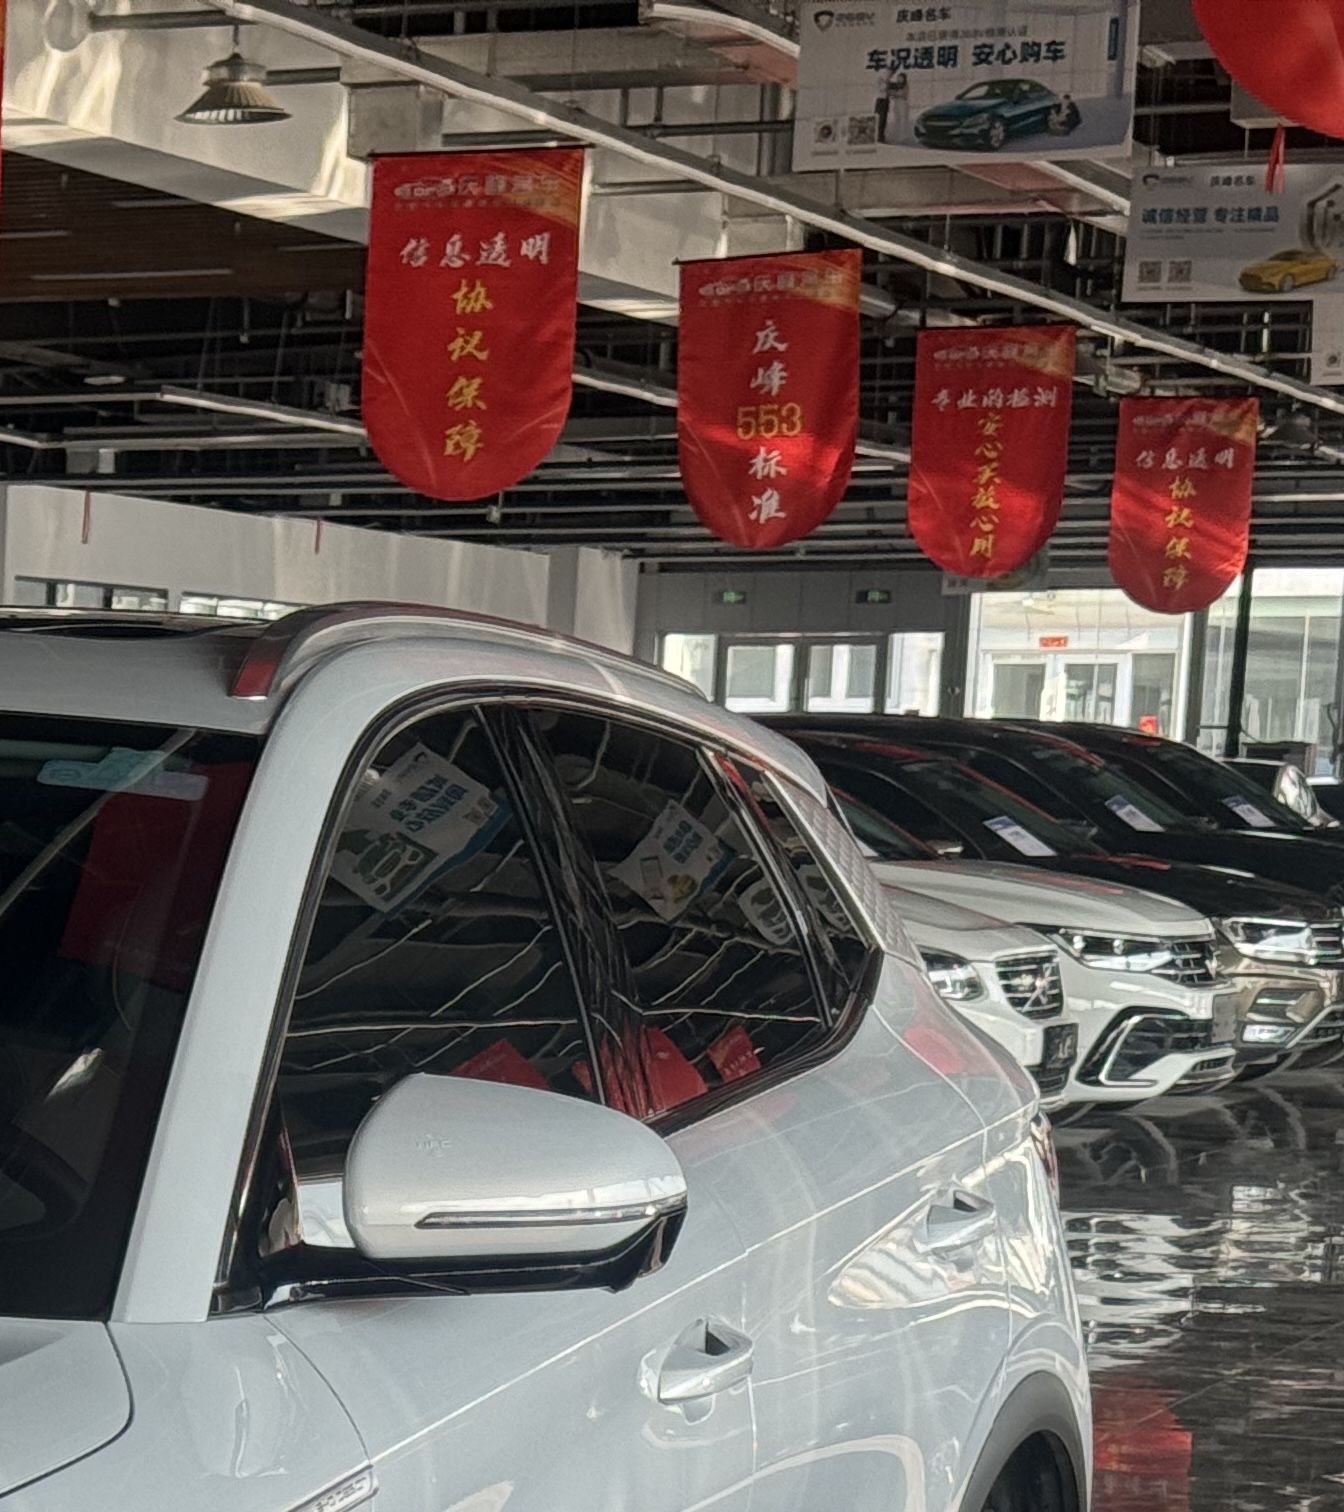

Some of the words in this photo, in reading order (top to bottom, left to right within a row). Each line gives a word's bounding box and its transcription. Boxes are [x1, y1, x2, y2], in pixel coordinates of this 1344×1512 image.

[866, 46, 959, 72] 车况透明
[971, 40, 1067, 65] 安心购车
[1141, 206, 1209, 224] 诚信经营
[1213, 205, 1280, 223] 专注精品
[399, 231, 551, 269] 信息透明
[442, 277, 494, 462] 协议保障
[1135, 447, 1236, 470] 信息透明
